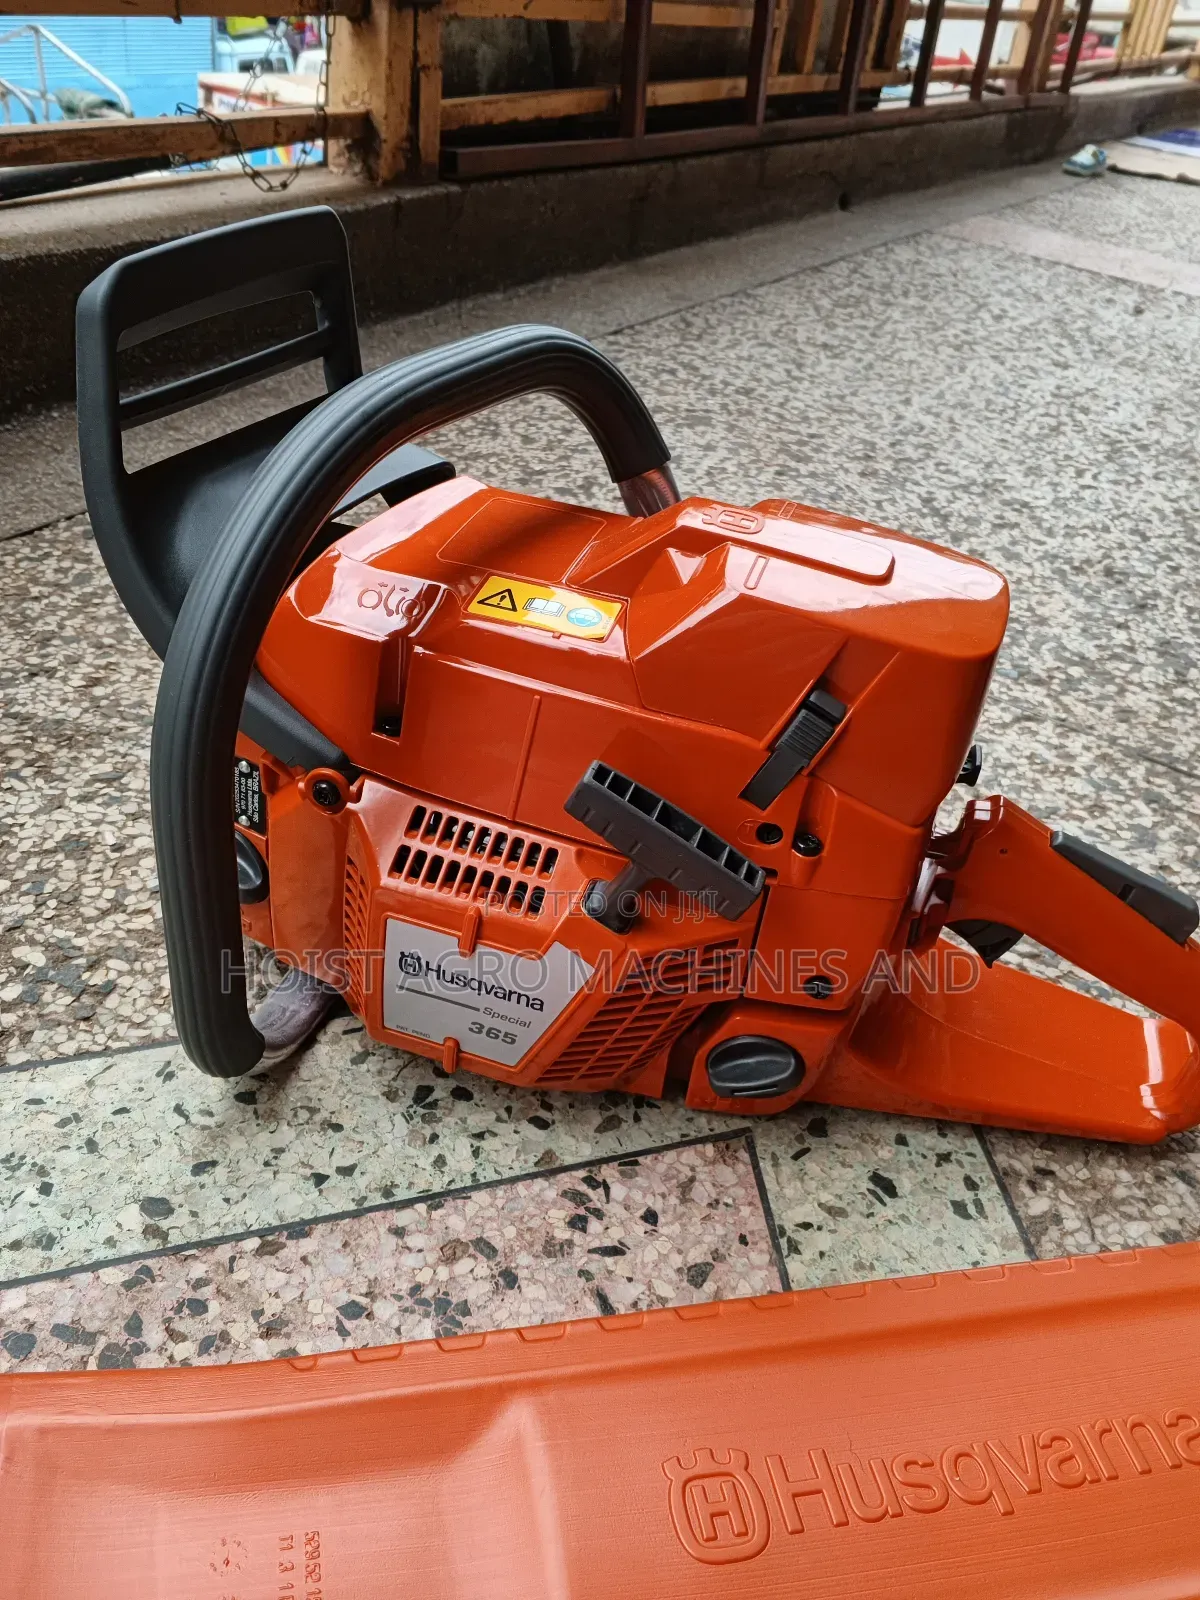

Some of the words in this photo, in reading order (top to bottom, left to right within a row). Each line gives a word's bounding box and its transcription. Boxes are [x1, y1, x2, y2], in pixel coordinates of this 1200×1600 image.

[425, 960, 545, 1013] Husqvarna
[482, 1006, 532, 1029] Special
[468, 1021, 518, 1046] 365
[765, 1407, 1200, 1535] Husqvarna
[303, 1530, 321, 1560] 529
[304, 1562, 322, 1584] 52
